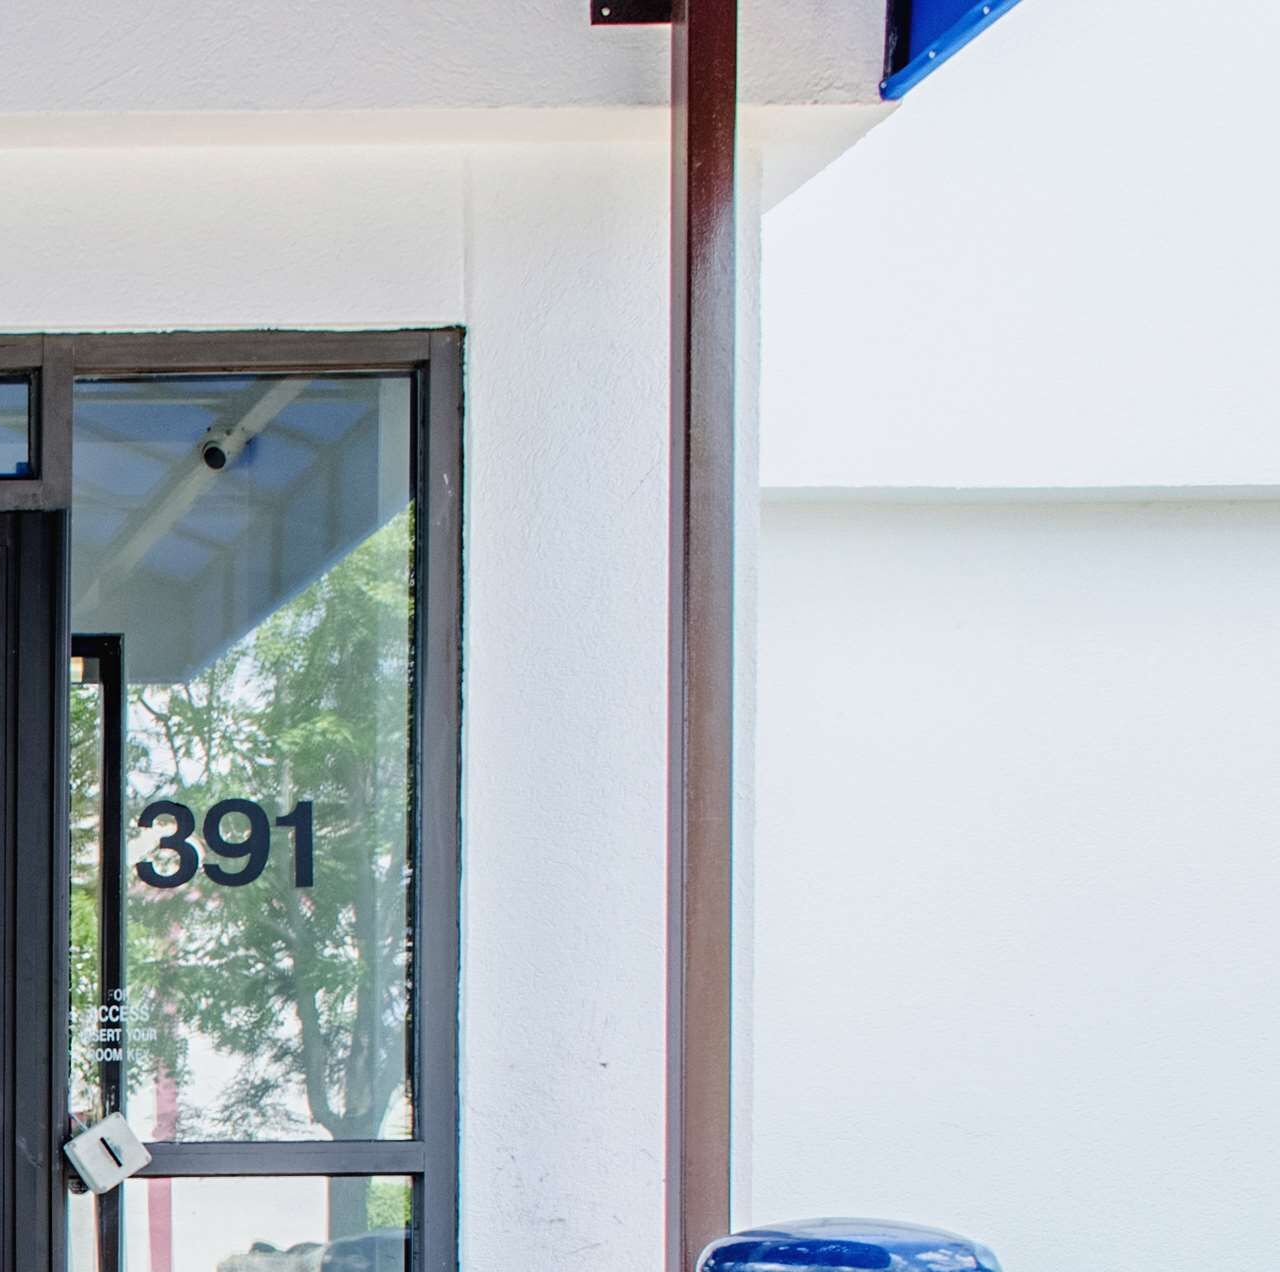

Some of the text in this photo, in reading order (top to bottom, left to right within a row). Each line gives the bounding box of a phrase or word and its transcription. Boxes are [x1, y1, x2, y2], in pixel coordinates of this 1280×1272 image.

[136, 799, 314, 888] 391
[89, 1005, 150, 1022] CCESS
[81, 1028, 122, 1041] SERT
